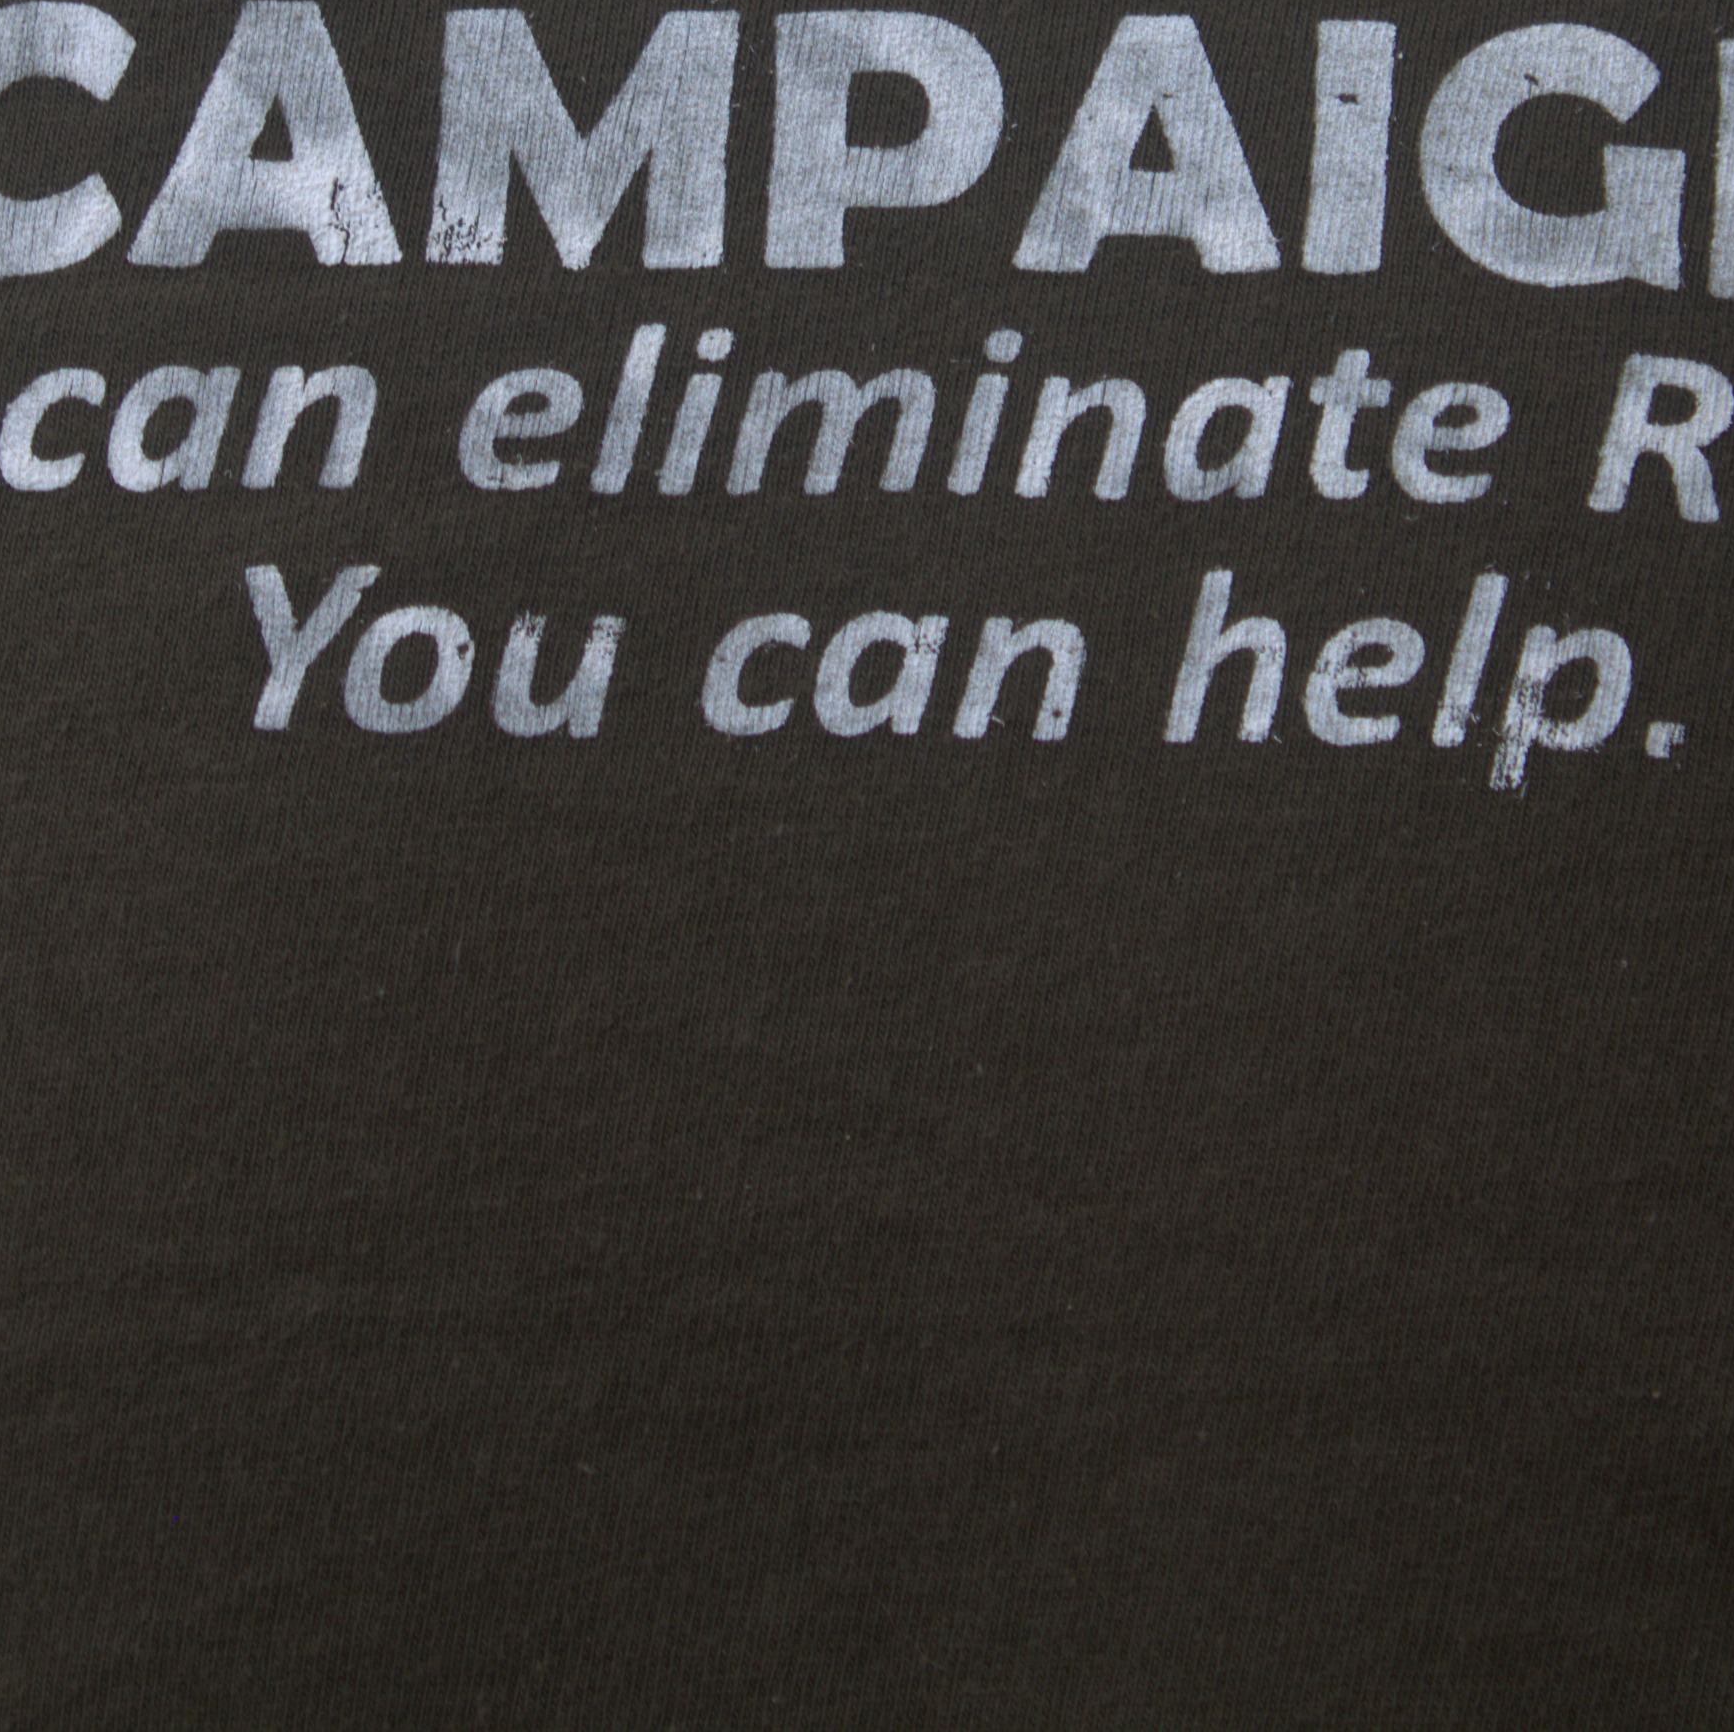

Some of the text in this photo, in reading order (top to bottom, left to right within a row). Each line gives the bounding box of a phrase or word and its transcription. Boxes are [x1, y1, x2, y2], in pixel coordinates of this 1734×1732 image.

[458, 321, 1511, 505] eliminate
[244, 563, 1684, 792] You can help.
